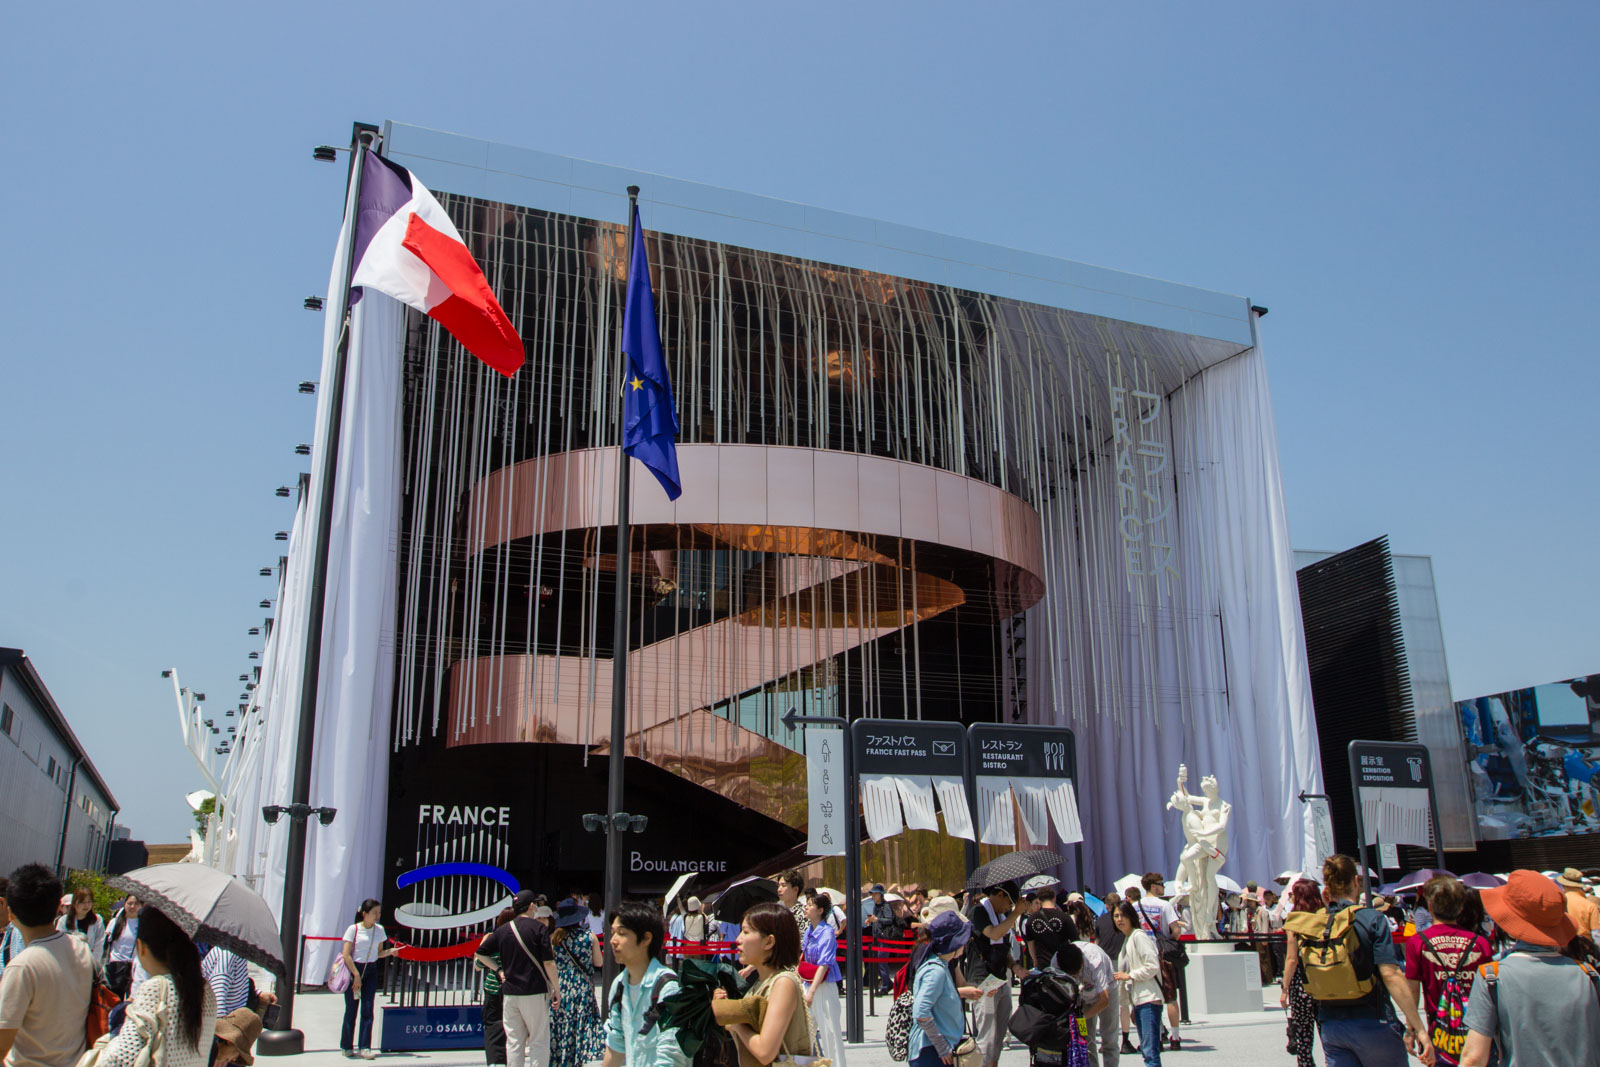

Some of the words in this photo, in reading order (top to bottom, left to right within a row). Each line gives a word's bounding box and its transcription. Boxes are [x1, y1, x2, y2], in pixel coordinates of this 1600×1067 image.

[1111, 386, 1145, 576] FRANCE
[1131, 389, 1180, 580] フランス
[866, 735, 916, 746] ファストパス
[982, 739, 1023, 751] レストラン
[911, 749, 927, 757] PASS
[982, 752, 1024, 760] RESTAURANT
[983, 761, 1007, 769] BISTRO
[1360, 755, 1384, 765] 展示室
[419, 804, 510, 826] FRANCE
[405, 1025, 433, 1033] EXPO
[436, 1023, 473, 1033] OSAKA
